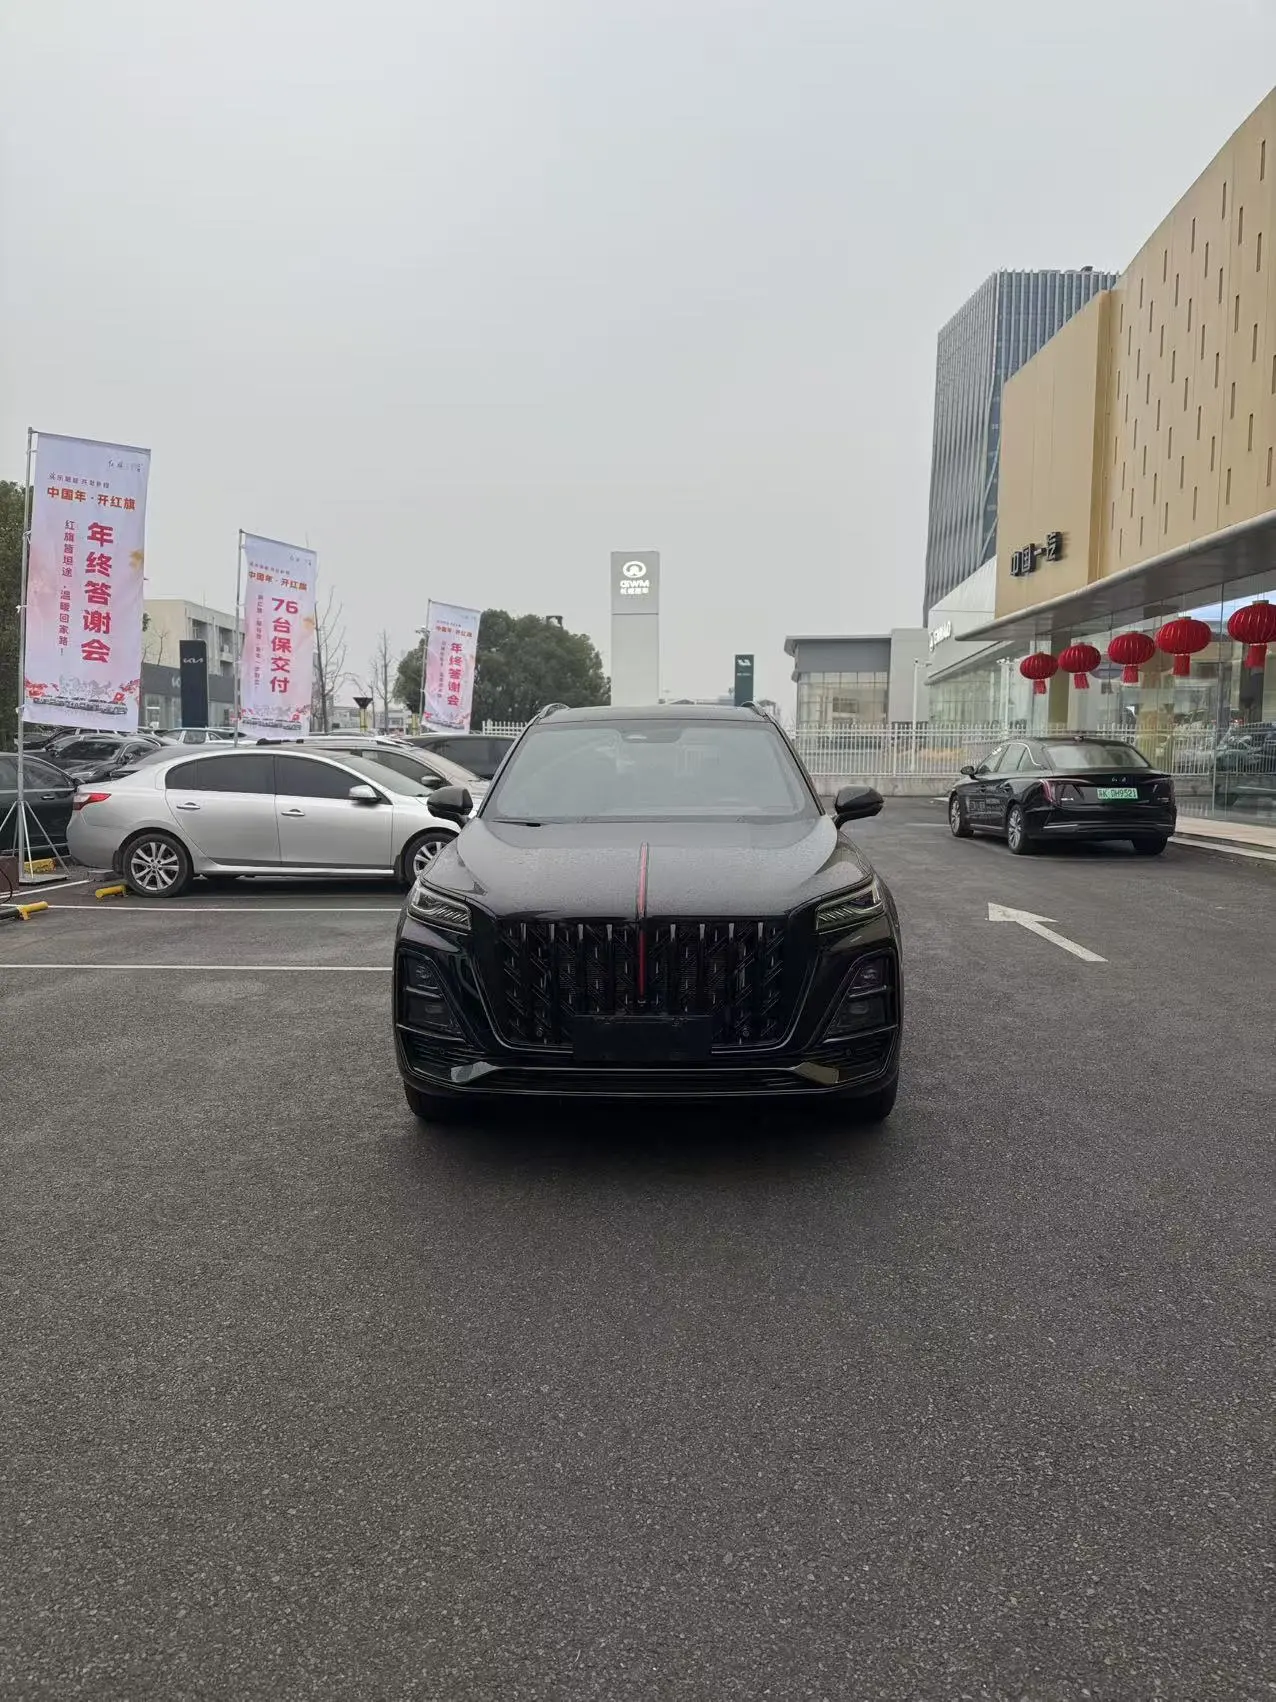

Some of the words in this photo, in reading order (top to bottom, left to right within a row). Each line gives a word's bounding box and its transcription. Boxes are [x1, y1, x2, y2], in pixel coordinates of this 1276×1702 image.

[81, 522, 114, 664] 年终答谢会
[269, 597, 299, 694] 76台保交付
[447, 642, 463, 706] 年终答谢会
